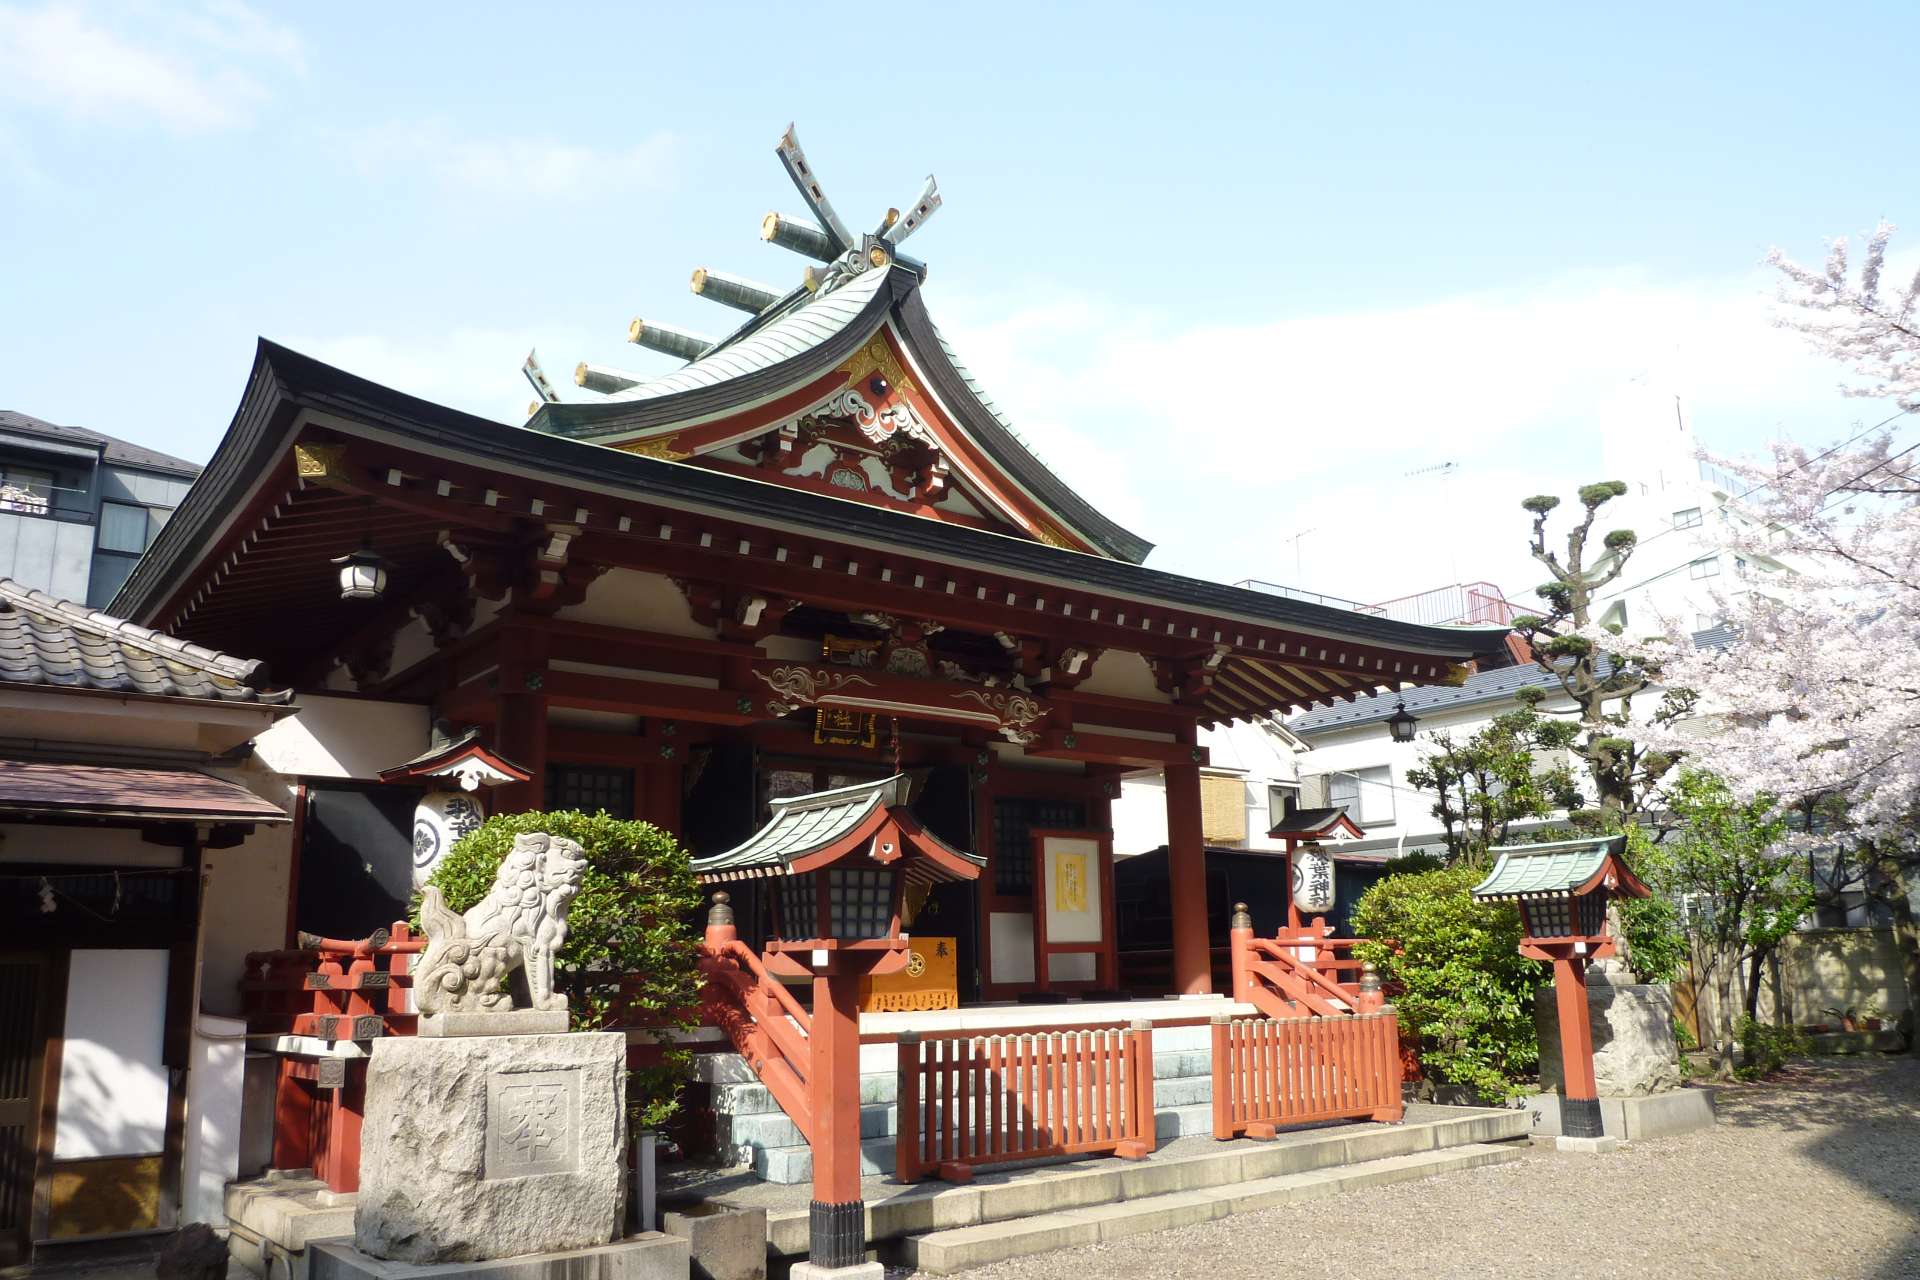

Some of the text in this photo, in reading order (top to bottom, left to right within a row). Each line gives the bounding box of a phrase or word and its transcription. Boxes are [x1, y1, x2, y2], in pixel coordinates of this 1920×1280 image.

[1306, 847, 1330, 907] 秋葉神社
[935, 941, 948, 959] 奉
[500, 1084, 567, 1162] 奉
